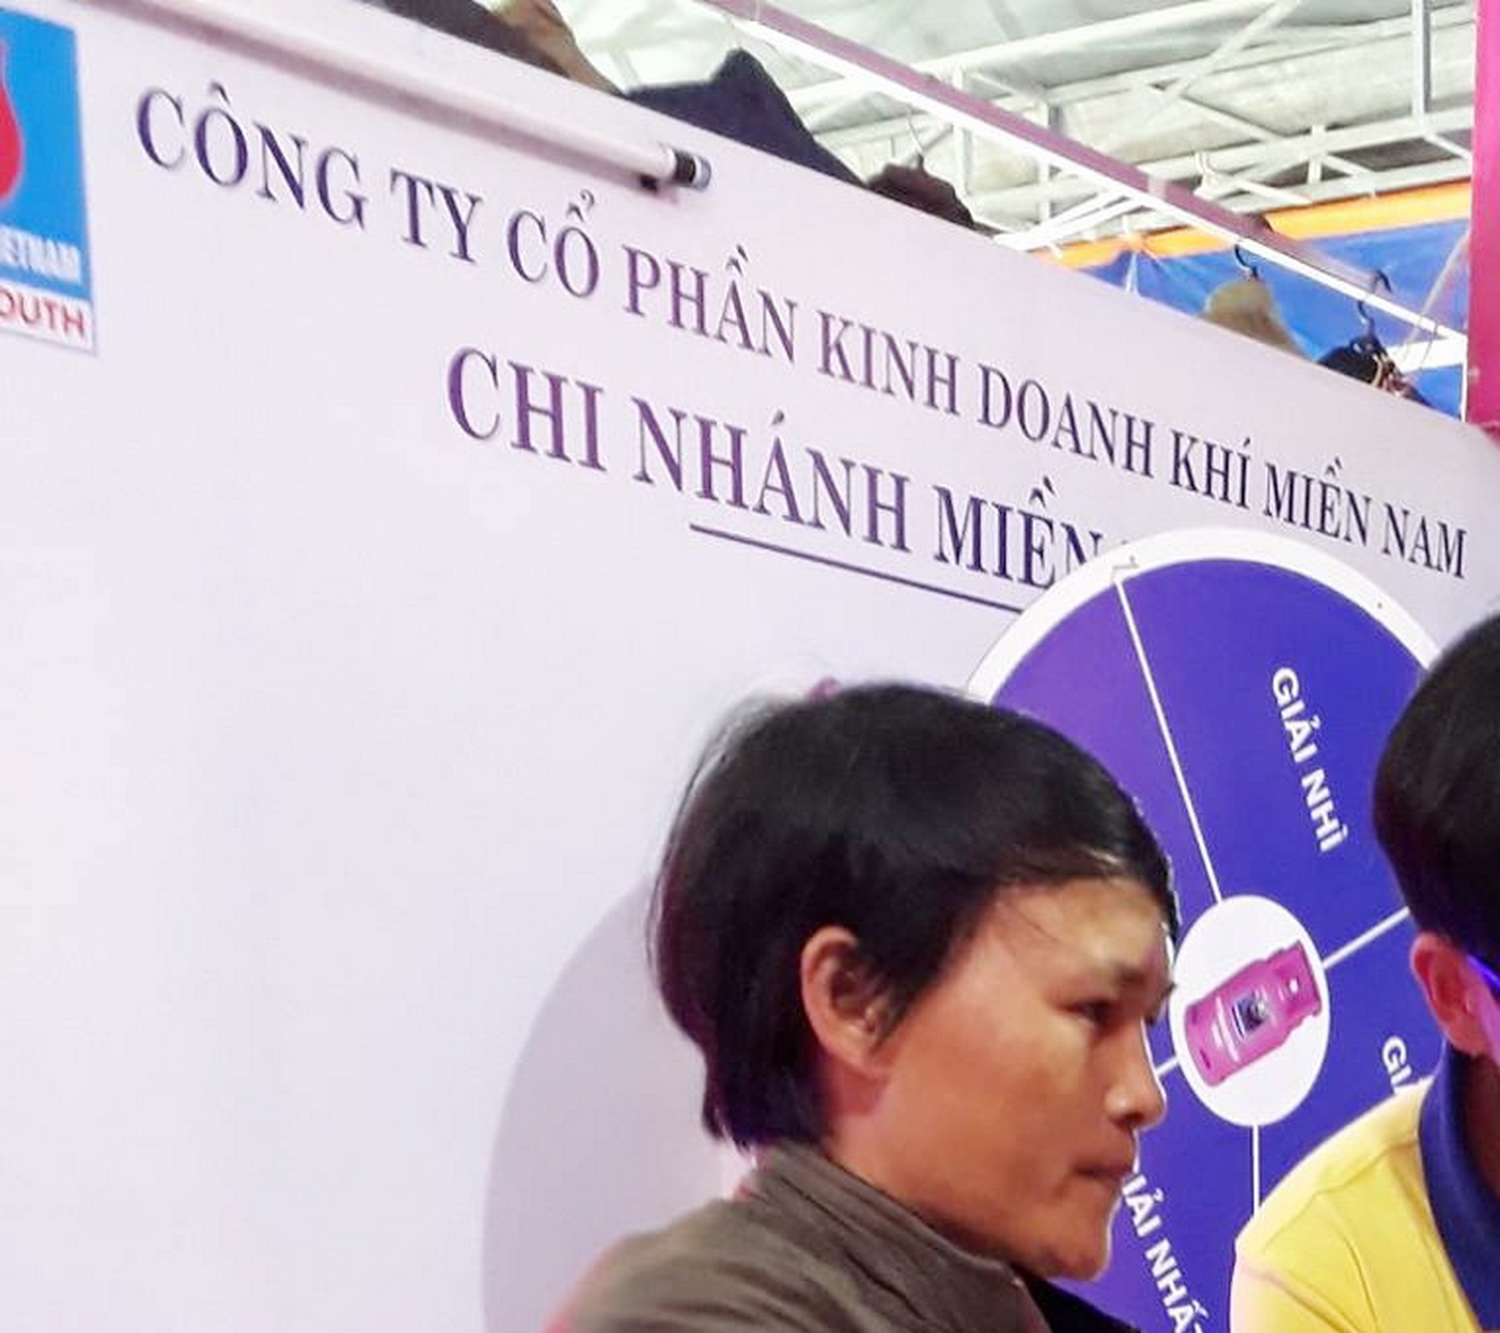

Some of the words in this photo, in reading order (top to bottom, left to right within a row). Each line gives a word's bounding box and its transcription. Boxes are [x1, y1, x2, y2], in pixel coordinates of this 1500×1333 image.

[136, 81, 367, 230] CÔNG
[390, 167, 483, 263] TY
[506, 190, 600, 299] CỔ
[622, 244, 797, 363] PHẦN
[817, 310, 959, 417] KINH
[977, 364, 1155, 479] DOANH
[1170, 428, 1252, 510] KHÍ
[1264, 456, 1372, 545] MIỀN
[1383, 502, 1467, 580] NAM
[448, 347, 608, 473] CHI
[631, 397, 911, 553] NHÁNH
[932, 478, 1104, 591] MIỀN
[1272, 667, 1317, 766] GIẢI
[1301, 767, 1348, 853] NHÌ
[1382, 1035, 1412, 1094] GI
[1121, 1158, 1164, 1237] IẢI
